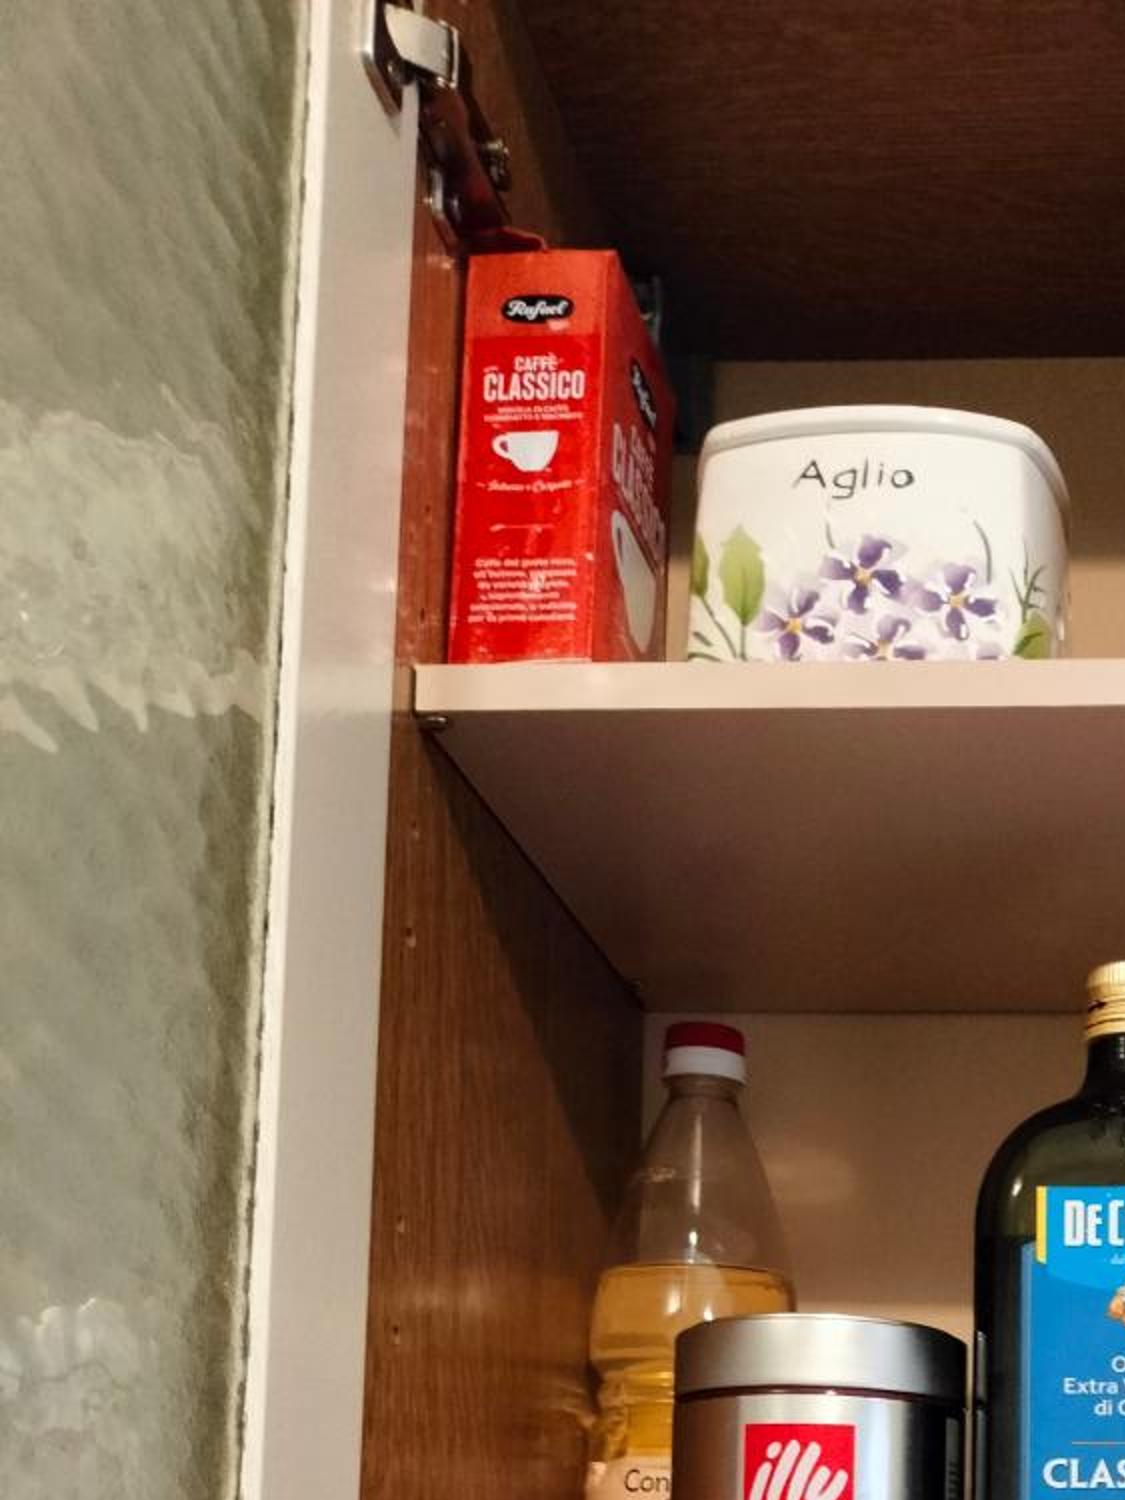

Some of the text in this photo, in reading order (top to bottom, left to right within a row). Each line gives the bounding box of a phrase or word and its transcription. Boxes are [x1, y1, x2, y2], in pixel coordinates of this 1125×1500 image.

[483, 369, 585, 402] CLASSICO
[792, 457, 915, 500] Aglio
[1063, 1377, 1119, 1395] Extra
[1094, 1399, 1113, 1416] di
